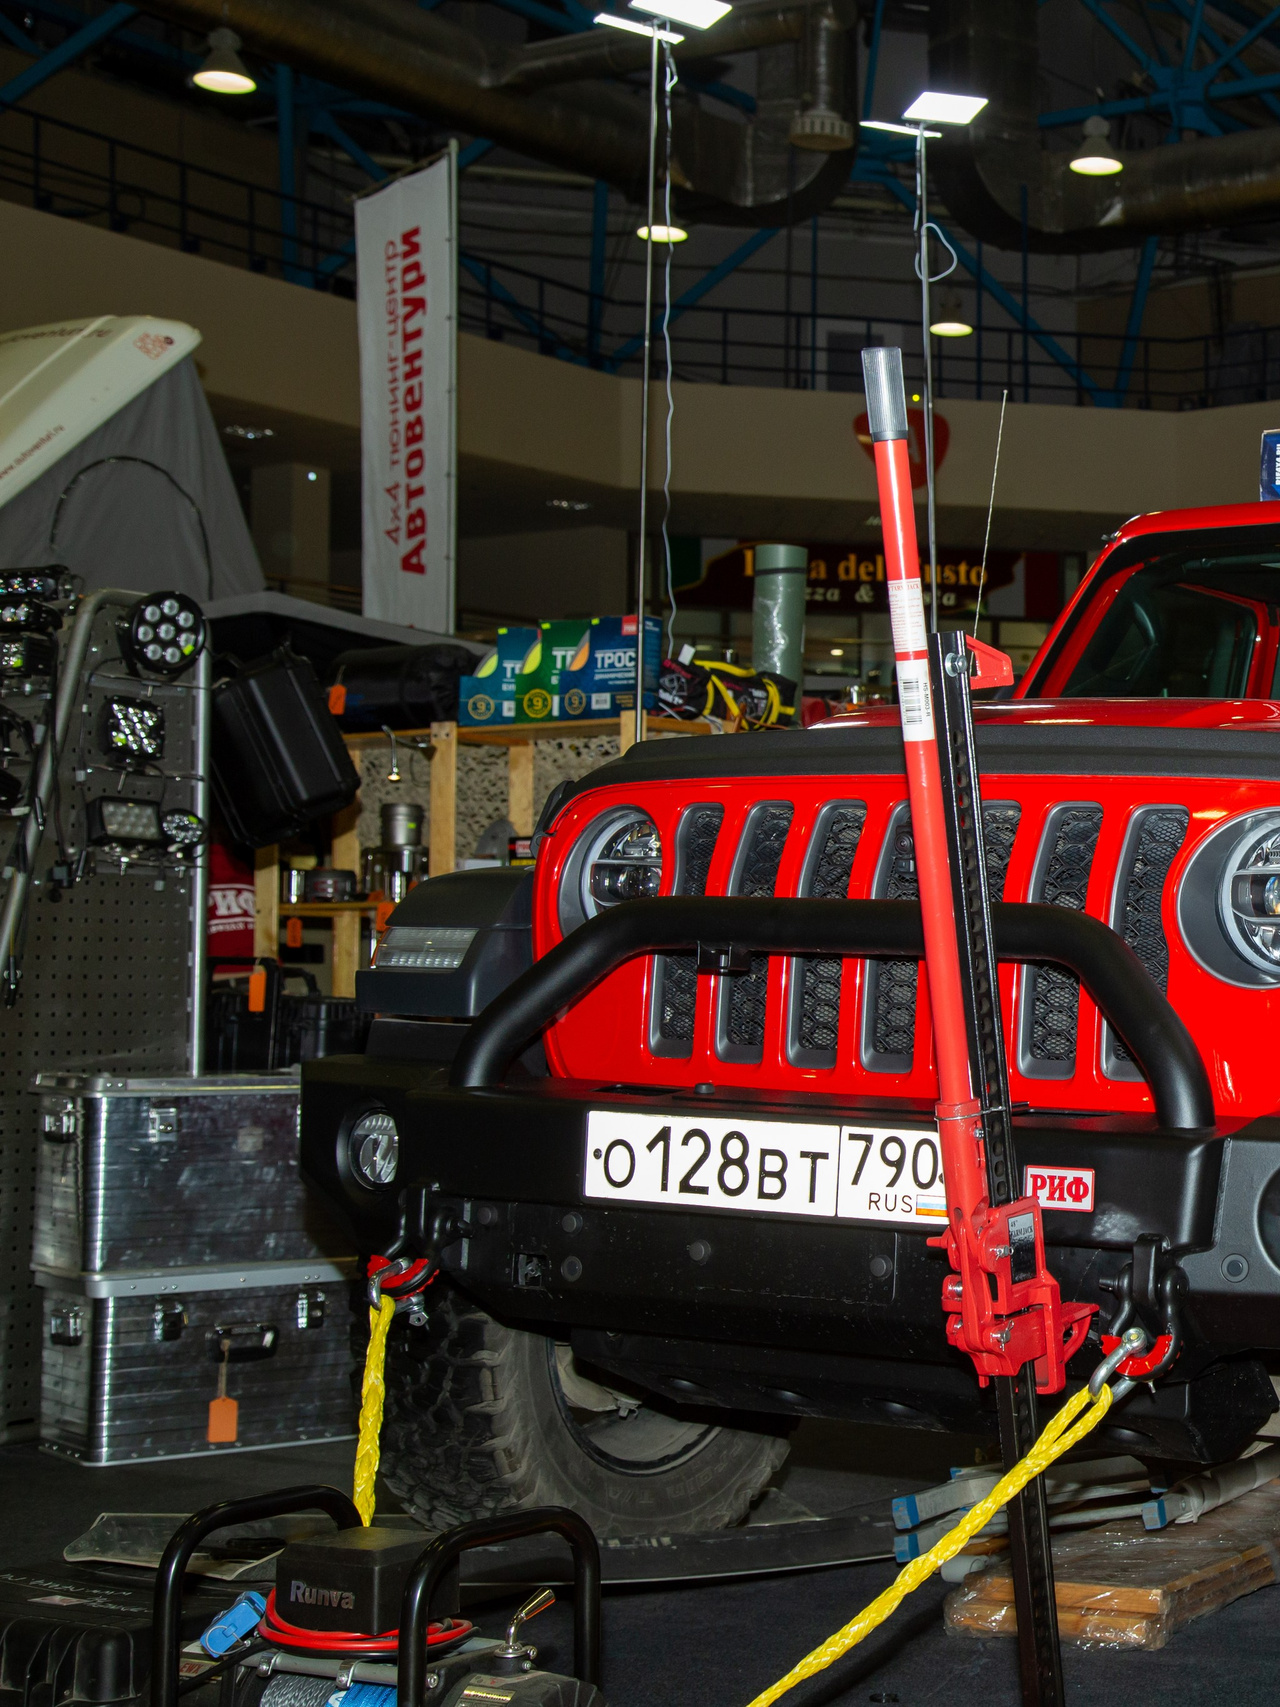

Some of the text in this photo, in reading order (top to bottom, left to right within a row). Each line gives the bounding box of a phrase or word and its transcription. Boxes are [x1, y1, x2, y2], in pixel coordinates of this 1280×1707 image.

[383, 239, 402, 466] тюнинг-центр
[400, 226, 428, 575] Автовентури
[838, 553, 884, 582] del
[925, 559, 989, 587] usto
[594, 652, 636, 669] ТРОС
[847, 1132, 939, 1189] 790
[867, 1191, 914, 1214] RUS
[1029, 1173, 1090, 1204] РИФ
[290, 1580, 354, 1610] Runva
